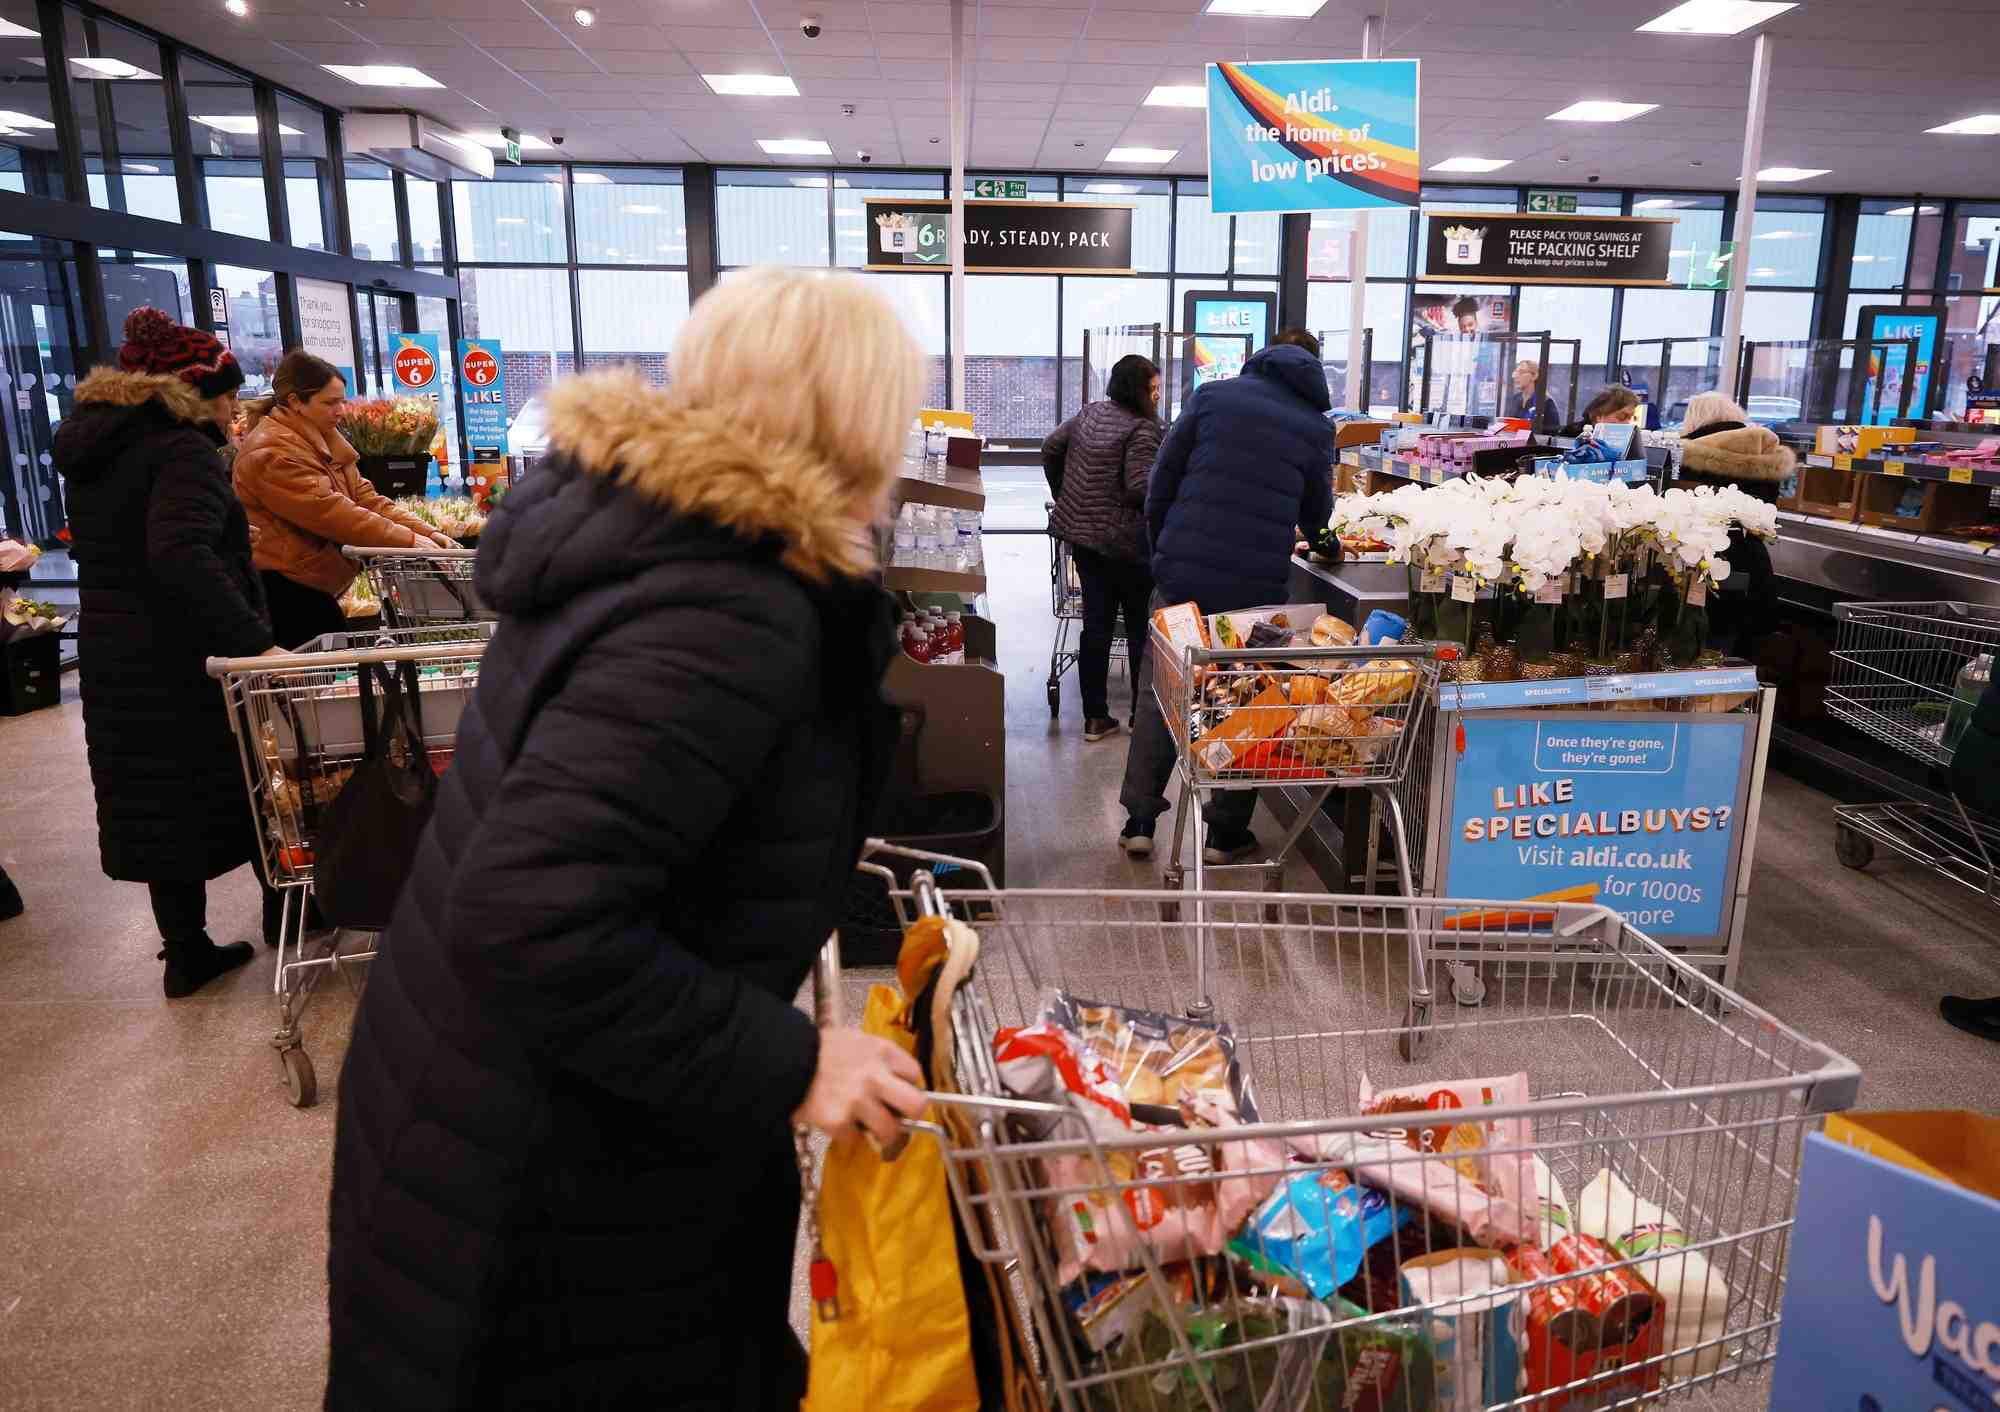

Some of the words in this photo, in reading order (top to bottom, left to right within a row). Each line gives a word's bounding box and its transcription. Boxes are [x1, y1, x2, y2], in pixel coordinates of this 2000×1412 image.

[1284, 88, 1339, 113] Aldi.
[1246, 123, 1280, 142] the
[1285, 123, 1344, 142] home
[1349, 123, 1370, 142] of
[1252, 160, 1298, 183] low
[1304, 150, 1387, 182] prices.
[918, 224, 935, 246] 6
[999, 230, 1064, 248] STEADY,
[1069, 232, 1110, 248] PACK
[1510, 229, 1542, 240] PLEASE
[1544, 230, 1566, 240] PACK
[1568, 231, 1591, 241] YOUR
[1593, 232, 1630, 242] SAVINGS
[1631, 233, 1643, 242] AT
[1509, 242, 1535, 255] THE
[1538, 242, 1595, 257] PACKING
[1598, 244, 1641, 258] SHELF
[1514, 257, 1533, 266] helps
[1534, 258, 1551, 267] keep
[1565, 259, 1585, 267] prices
[1883, 324, 1923, 340] LIKE
[397, 357, 431, 368] SUPER
[465, 360, 495, 369] SUPER
[409, 368, 422, 384] 6
[475, 369, 487, 383] 6
[464, 391, 502, 403] LIKE
[1546, 736, 1578, 748] Once
[1580, 736, 1627, 751] they're
[1628, 739, 1665, 751] gone,
[1561, 752, 1606, 766] they're
[1609, 753, 1647, 766] gone!
[1495, 778, 1575, 810] LIKE
[1464, 805, 1732, 841] SPECIALBUYS?
[1518, 845, 1565, 866] Visit
[1569, 846, 1692, 870] aldi.co.uk
[1603, 875, 1636, 897] for
[1641, 880, 1702, 903] 1000s
